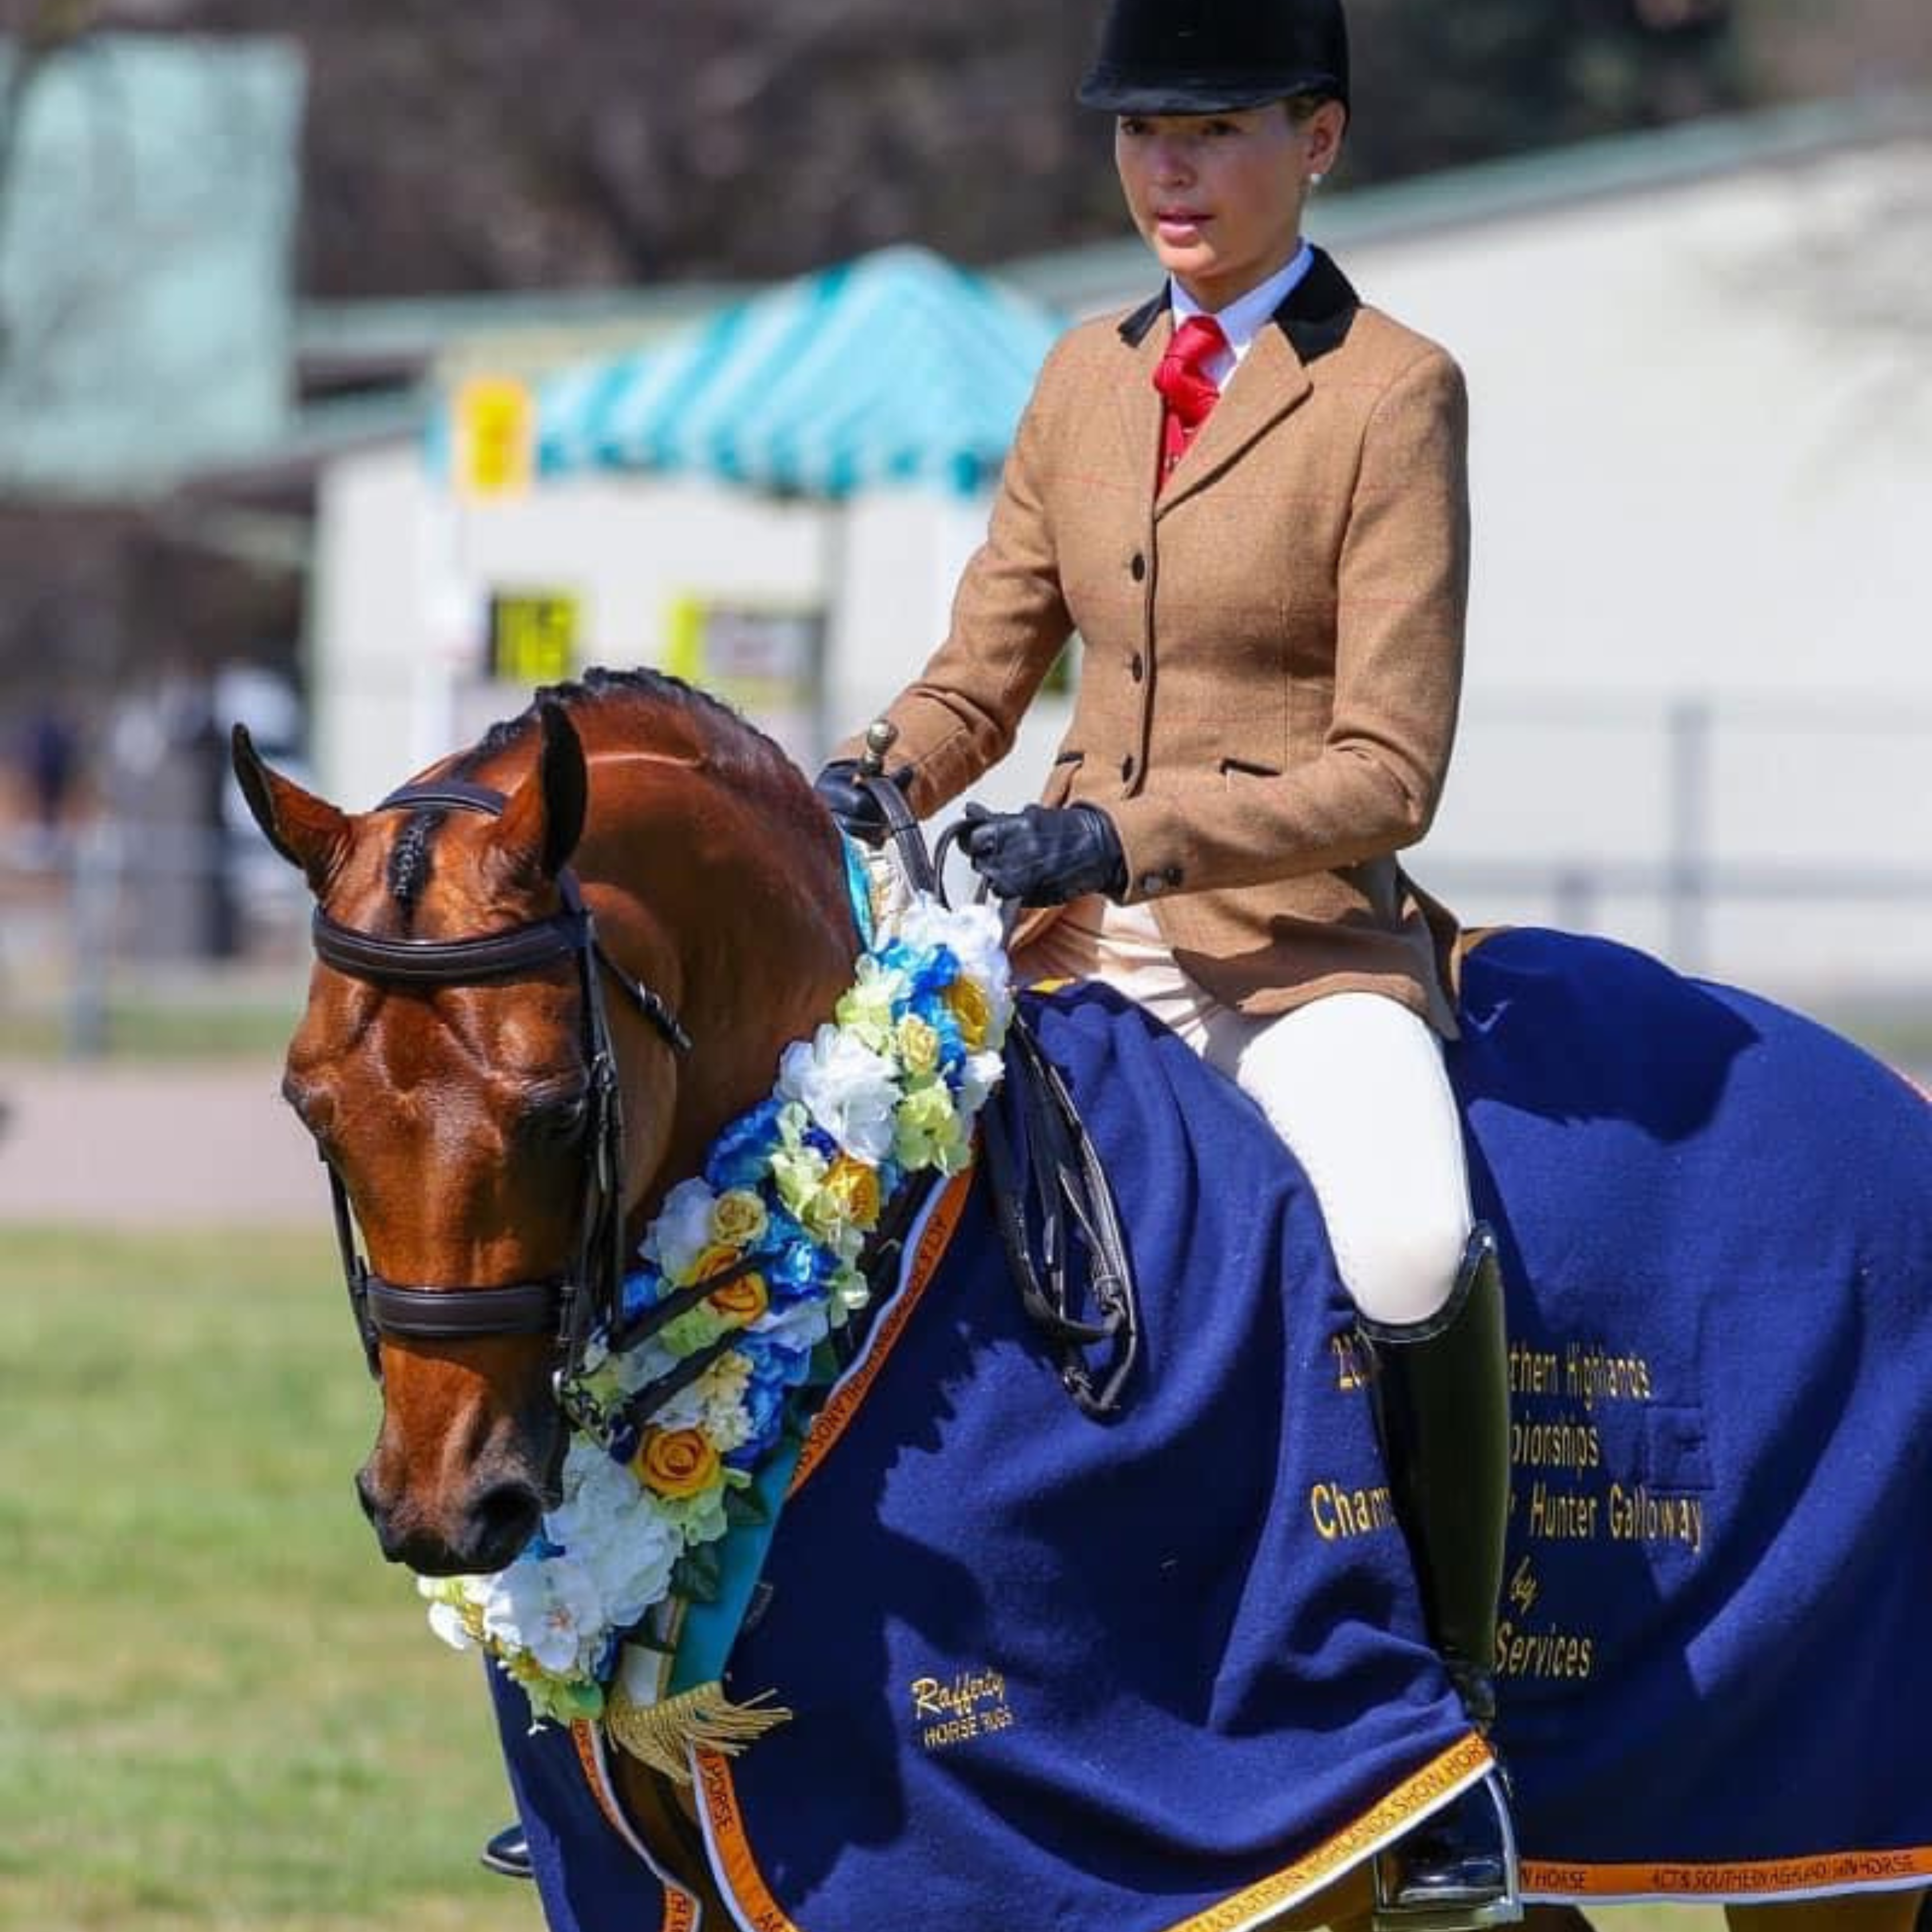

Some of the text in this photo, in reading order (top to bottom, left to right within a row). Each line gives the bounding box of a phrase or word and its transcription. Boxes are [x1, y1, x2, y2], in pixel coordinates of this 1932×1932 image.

[1509, 1341, 1558, 1395] thern
[1310, 1481, 1397, 1541] Cham
[1531, 1481, 1597, 1539] Hunter
[1610, 1482, 1702, 1554] Galloway
[1509, 1554, 1537, 1615] by
[1494, 1622, 1593, 1677] Services
[923, 1716, 980, 1749] HORSE
[1445, 1738, 1485, 1777] HOR
[1535, 1868, 1587, 1890] HORSE
[1859, 1854, 1914, 1875] HORSE
